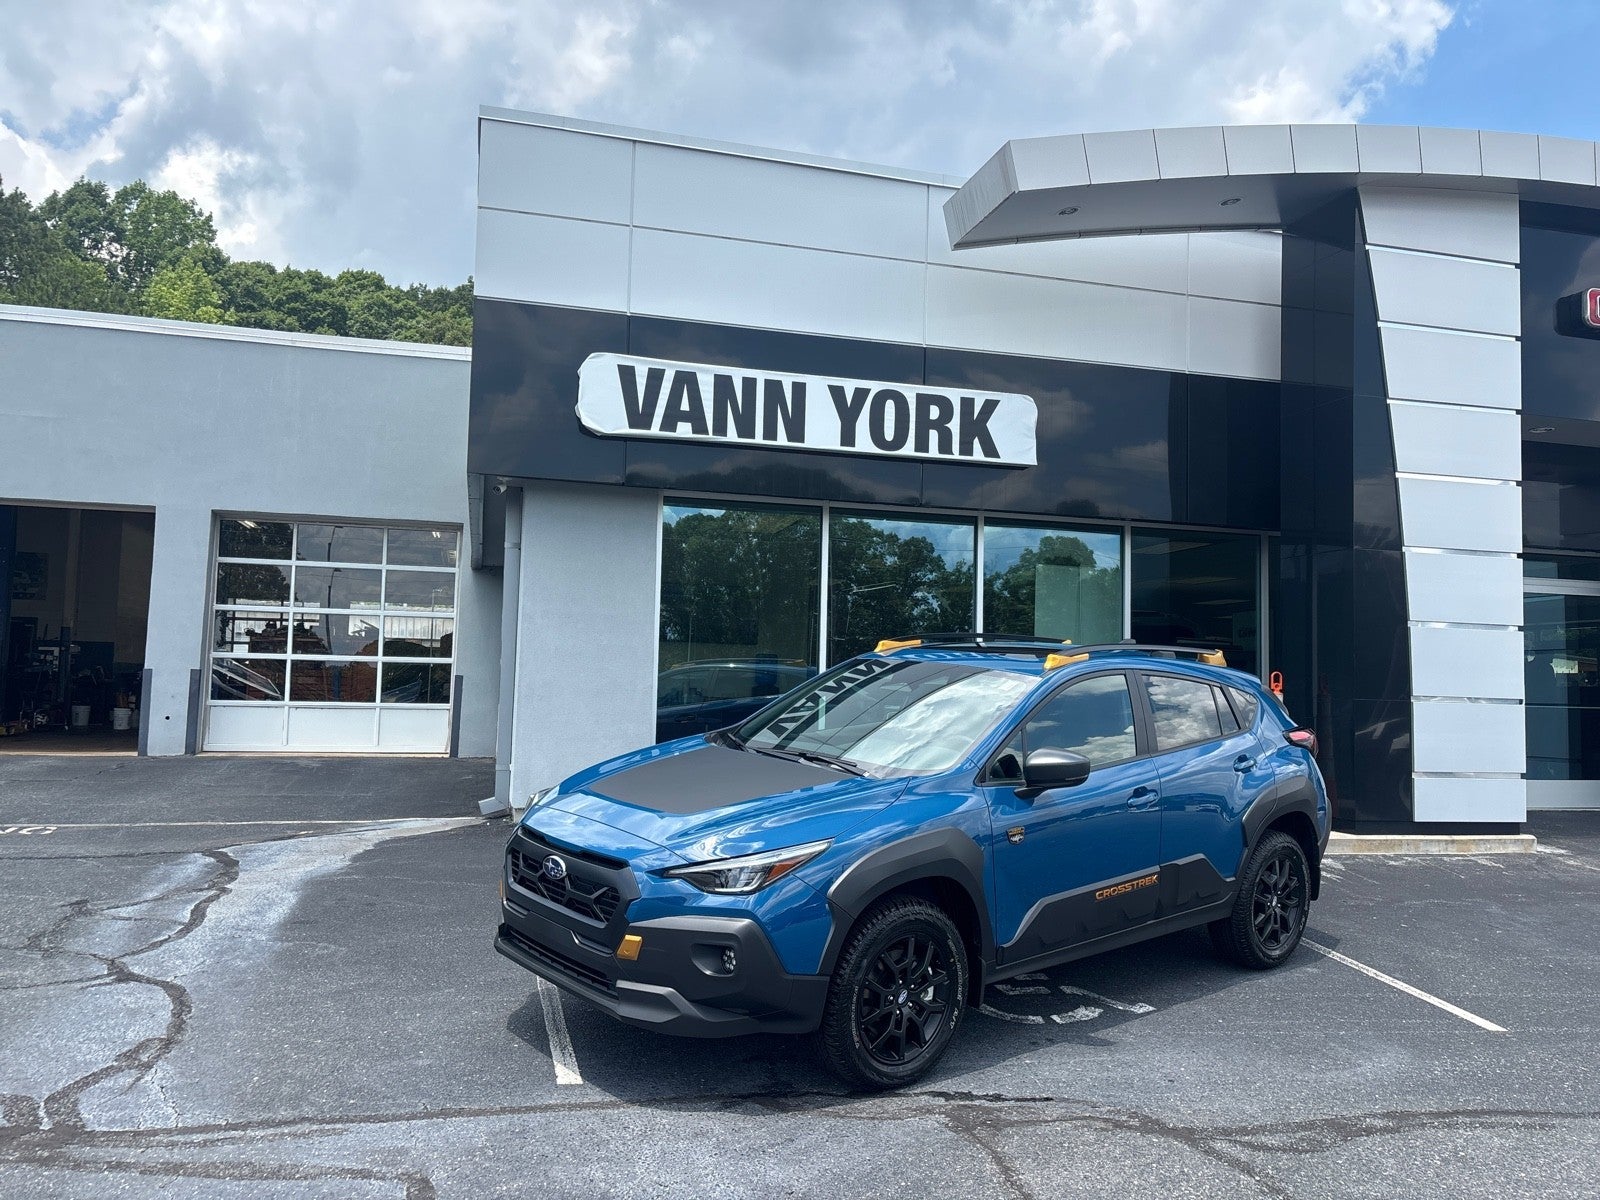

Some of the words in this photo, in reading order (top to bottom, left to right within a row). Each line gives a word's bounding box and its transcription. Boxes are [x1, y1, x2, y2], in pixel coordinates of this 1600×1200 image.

[617, 364, 807, 444] VANN
[827, 384, 1002, 459] YORK
[1095, 874, 1160, 900] CROSSTREK
